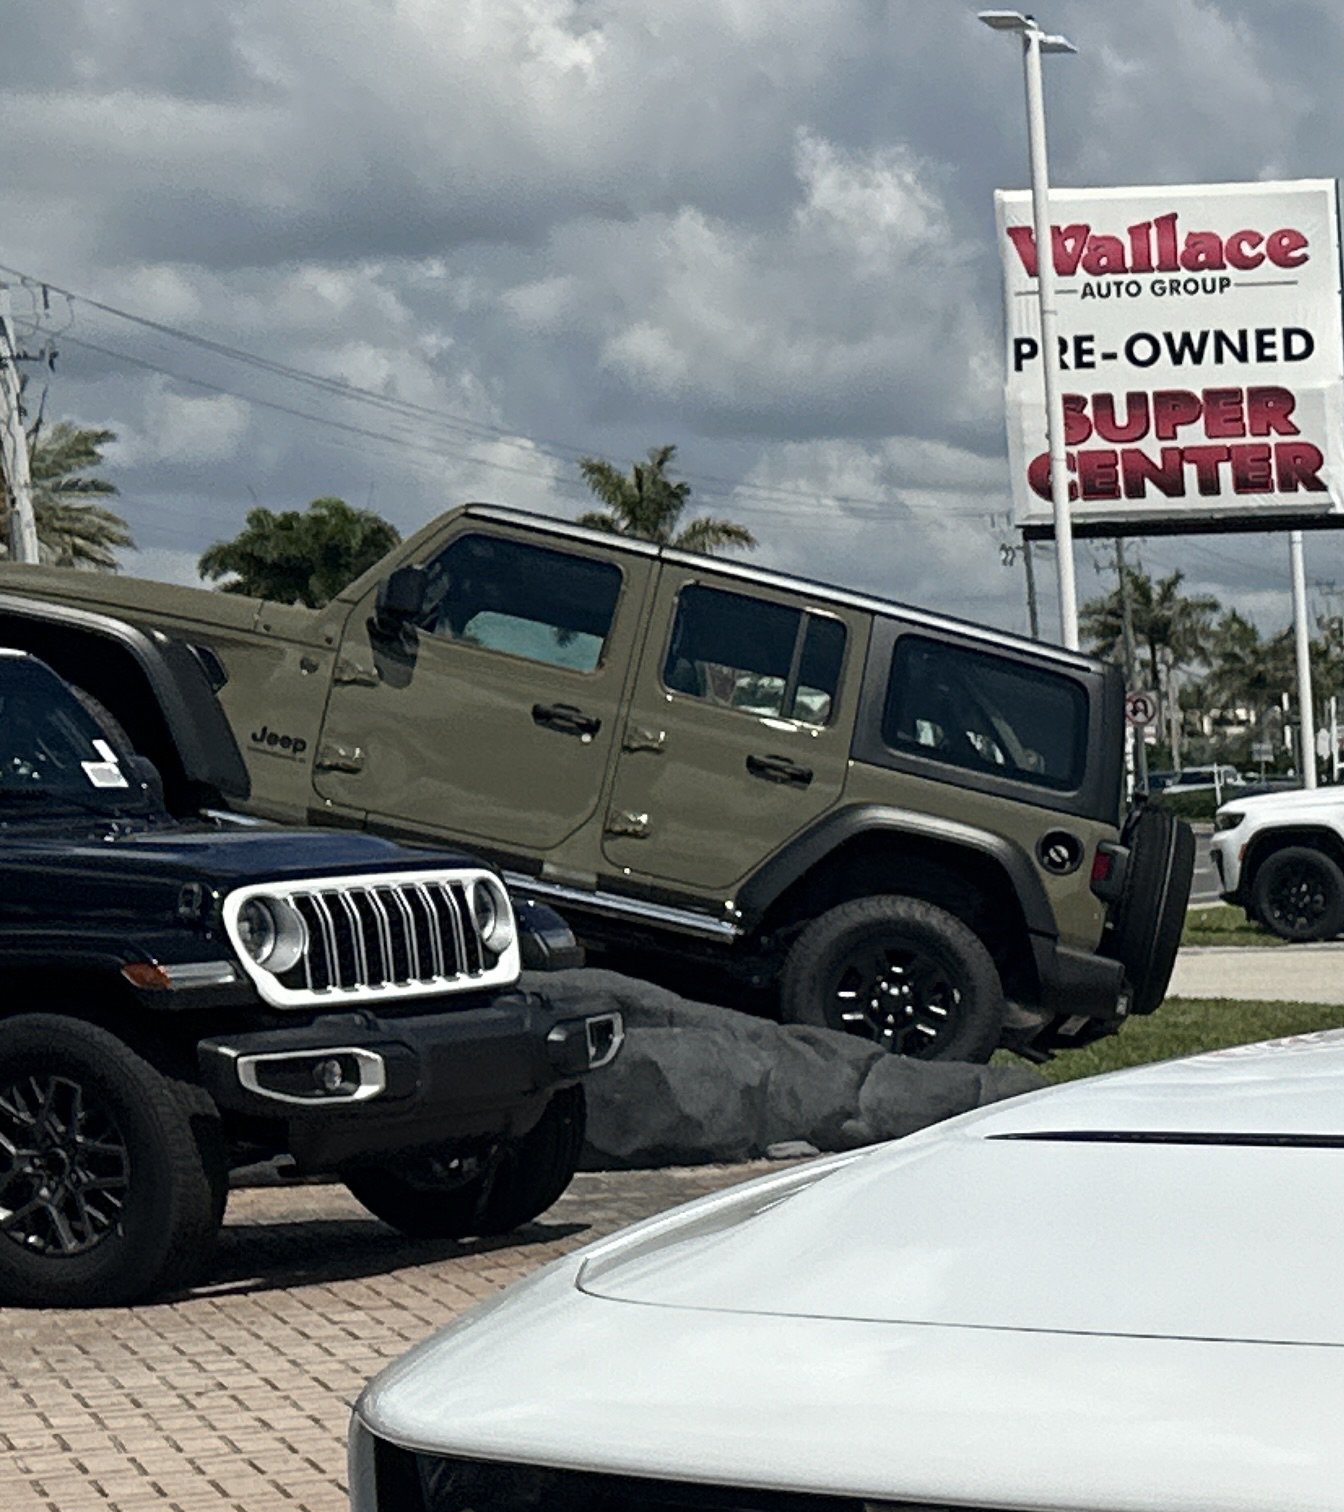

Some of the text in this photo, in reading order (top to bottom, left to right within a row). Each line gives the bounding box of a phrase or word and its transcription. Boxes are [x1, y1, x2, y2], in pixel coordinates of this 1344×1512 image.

[1007, 212, 1309, 277] Wallace
[1081, 276, 1232, 299] AUTO GROUP
[1027, 441, 1329, 502] CENTER
[251, 725, 307, 755] Jeep
